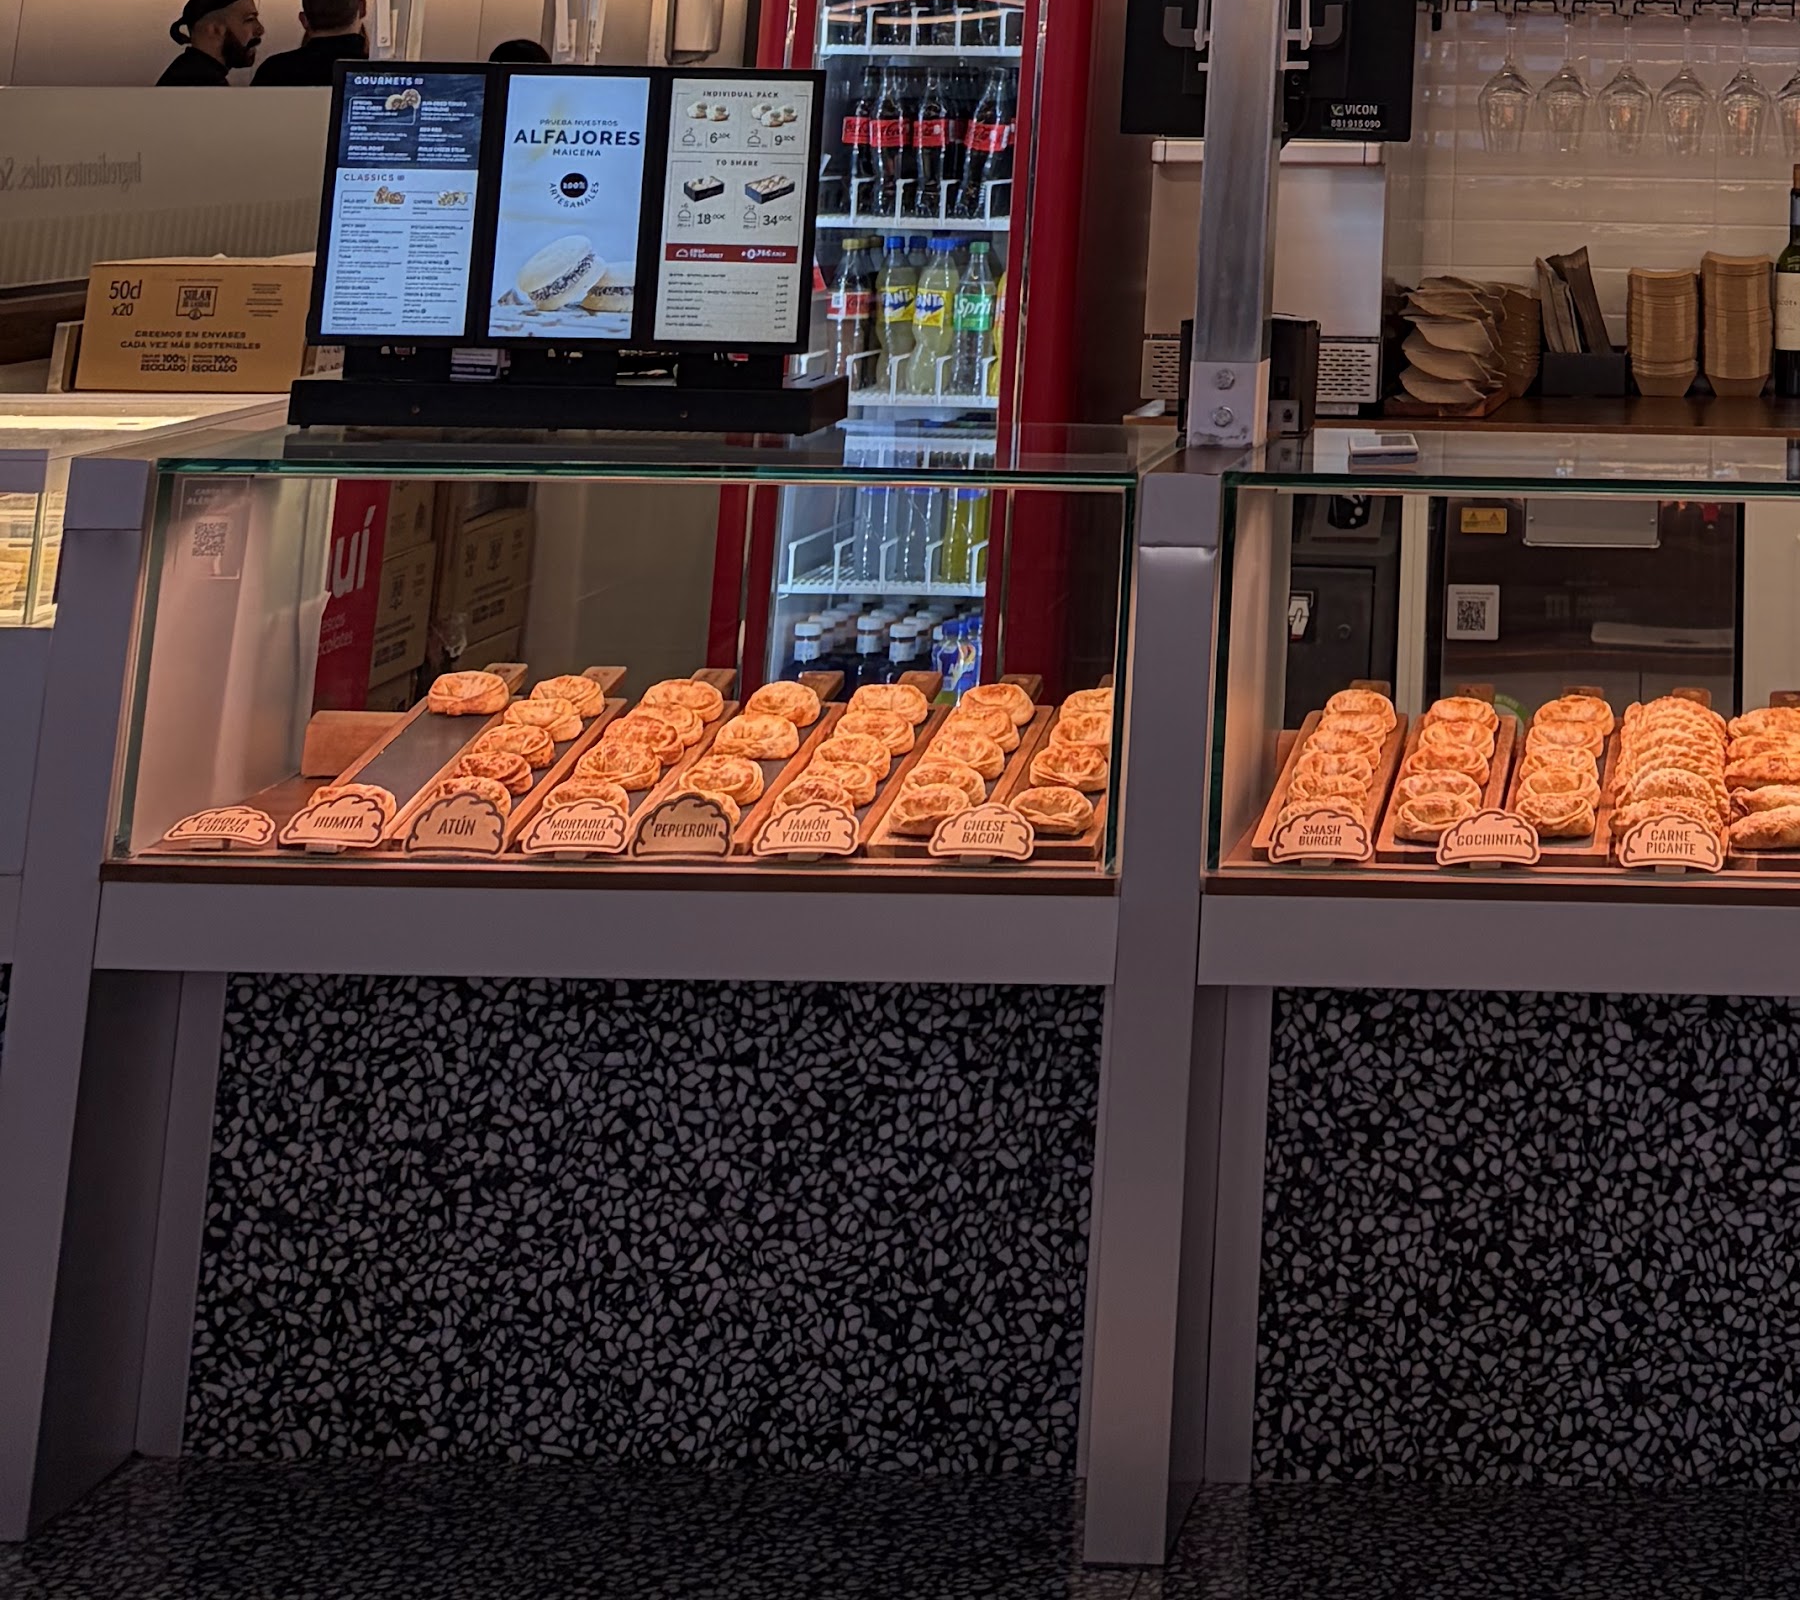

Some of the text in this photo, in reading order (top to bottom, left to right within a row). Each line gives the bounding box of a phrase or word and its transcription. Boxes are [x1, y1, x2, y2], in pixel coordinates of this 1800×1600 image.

[1345, 104, 1378, 115] VICON
[513, 129, 640, 146] ALFAJORES
[552, 148, 601, 156] MAICENA
[202, 331, 246, 339] ENVASES
[120, 341, 147, 349] CADA
[149, 341, 168, 349] VEZ
[313, 816, 364, 829] HUMITA
[438, 815, 476, 836] ATÚN
[551, 819, 614, 830] MORTADELA
[788, 817, 829, 831] JAMÓN
[964, 820, 1008, 832] CHEESE
[654, 823, 719, 838] PEPPERONI
[1302, 824, 1341, 835] SMASH
[1651, 829, 1691, 842] CARNE
[551, 831, 606, 841] PISTACHO
[782, 831, 831, 842] Y QUESO
[962, 832, 1003, 845] BACON
[1298, 835, 1342, 846] BURGER
[1457, 834, 1522, 846] COCHINITA
[1647, 841, 1696, 856] PICANTE
